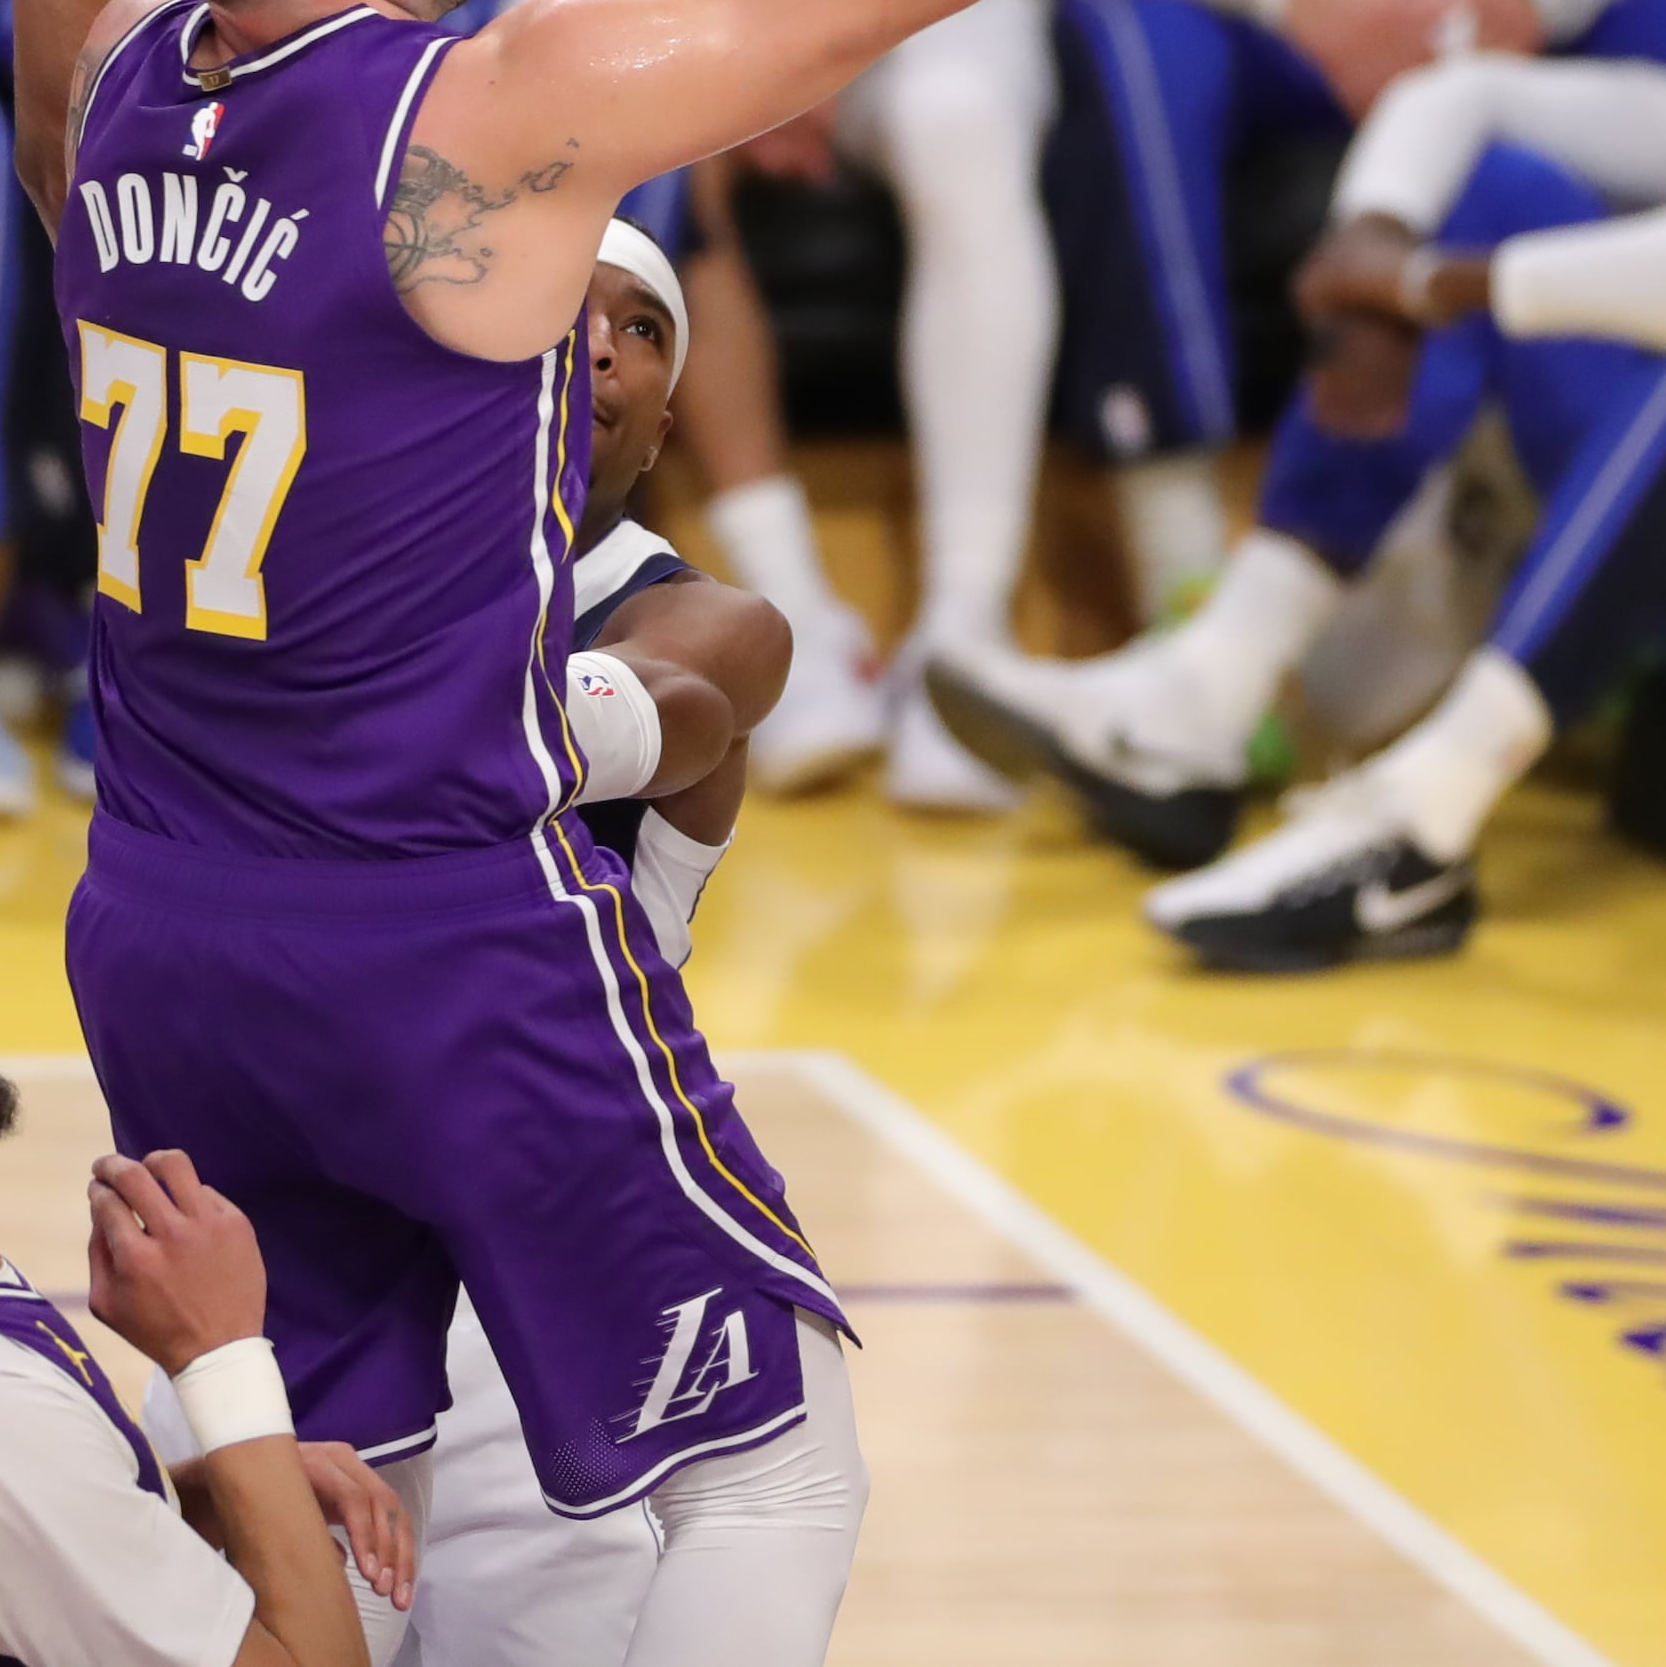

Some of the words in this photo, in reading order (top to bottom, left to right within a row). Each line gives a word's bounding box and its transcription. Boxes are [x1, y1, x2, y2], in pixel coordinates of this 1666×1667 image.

[79, 166, 309, 302] DONČIĆ
[77, 318, 307, 642] 77
[609, 1286, 760, 1445] LA
